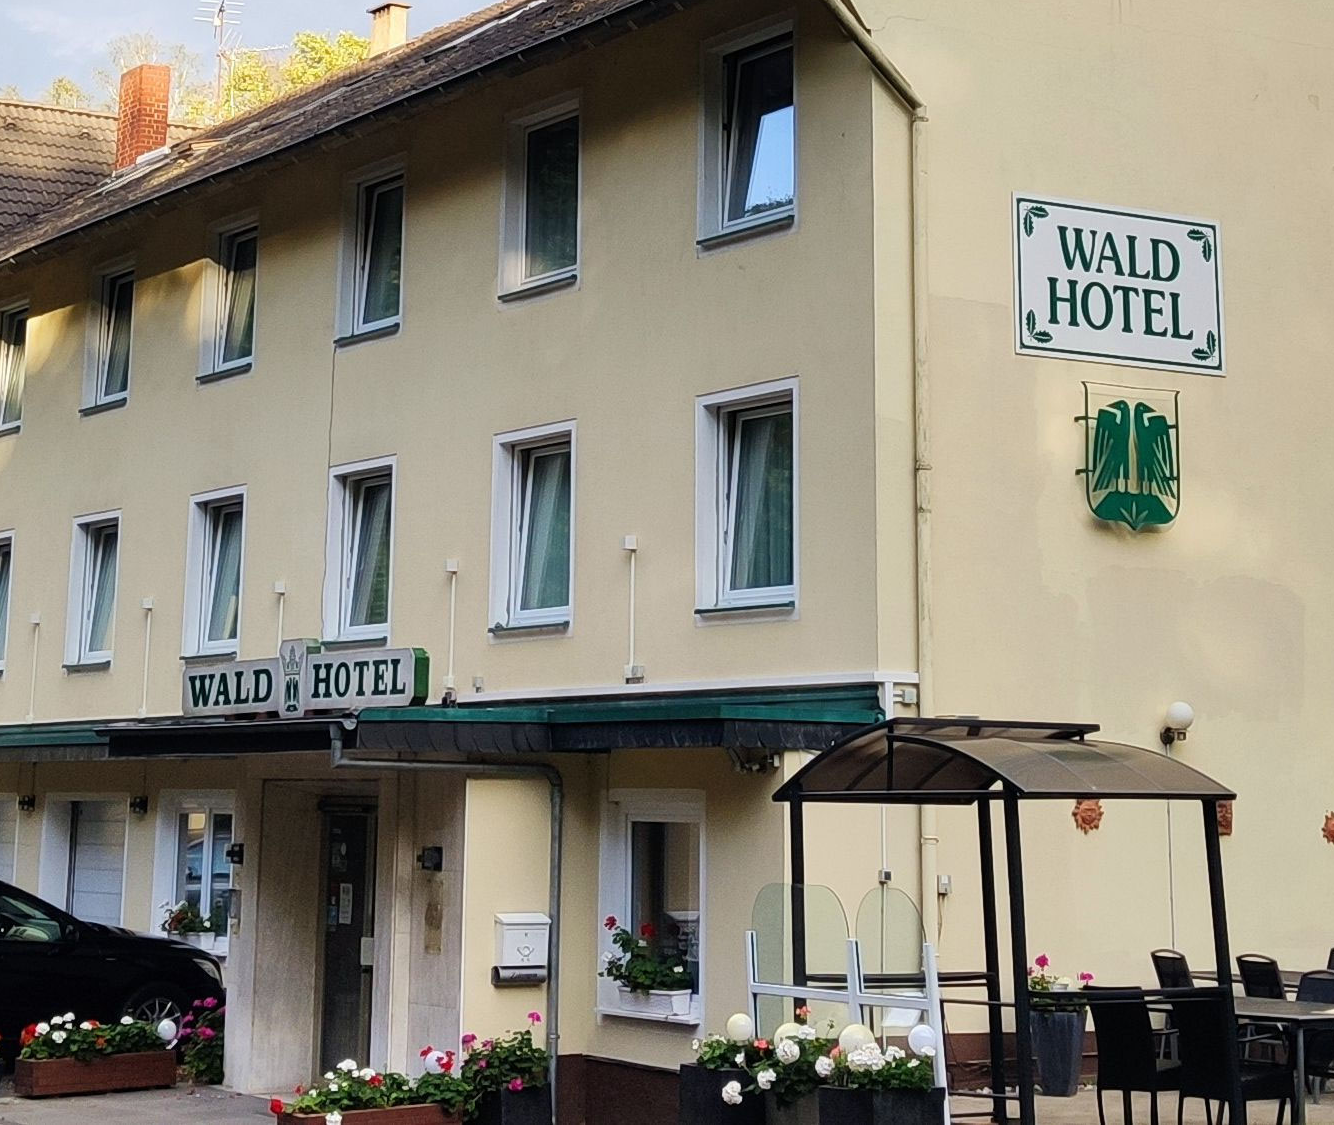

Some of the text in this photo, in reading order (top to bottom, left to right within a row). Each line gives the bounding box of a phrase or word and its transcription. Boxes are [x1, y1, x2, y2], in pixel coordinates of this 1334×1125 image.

[1057, 225, 1181, 282] WALD
[1047, 276, 1194, 341] HOTEL
[188, 658, 406, 707] WALD HOTEL
